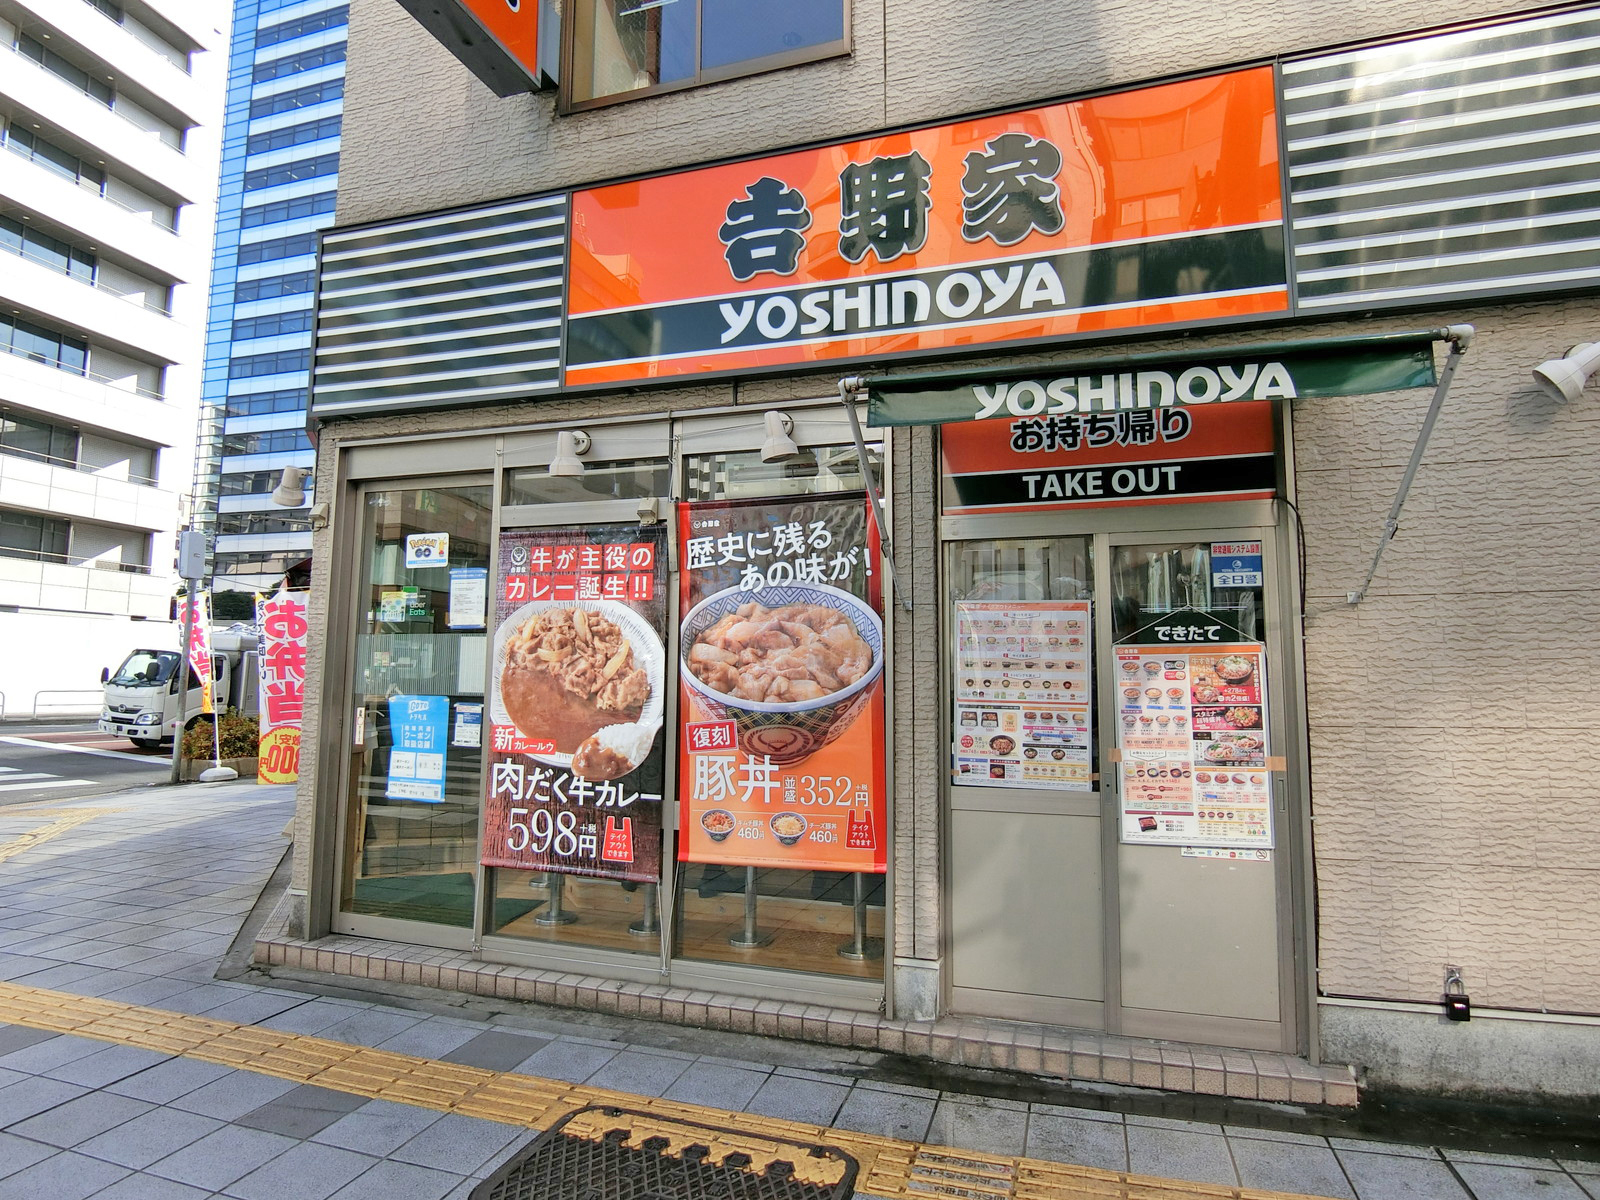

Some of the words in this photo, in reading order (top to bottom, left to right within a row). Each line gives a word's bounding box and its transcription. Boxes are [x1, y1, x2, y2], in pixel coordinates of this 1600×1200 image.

[718, 132, 1064, 283] 吉野家
[719, 261, 1066, 345] YOSHINOYA
[973, 362, 1298, 421] YOSHINOYA
[1010, 406, 1192, 453] お持ち帰り
[1022, 471, 1104, 500] TAKE
[1111, 466, 1182, 494] OUT
[531, 545, 652, 572] 牛が主役の
[686, 520, 832, 570] 歴史に残る
[1217, 574, 1258, 585] 全日警
[1154, 625, 1222, 641] できたて
[494, 726, 515, 751] 新
[514, 739, 555, 753] カレールウ
[692, 724, 731, 748] 復刻
[491, 757, 662, 808] 肉だく牛カレー
[693, 754, 781, 803] 豚丼
[784, 776, 797, 803] 並盛
[610, 833, 627, 841] テイク
[607, 850, 629, 859] できます
